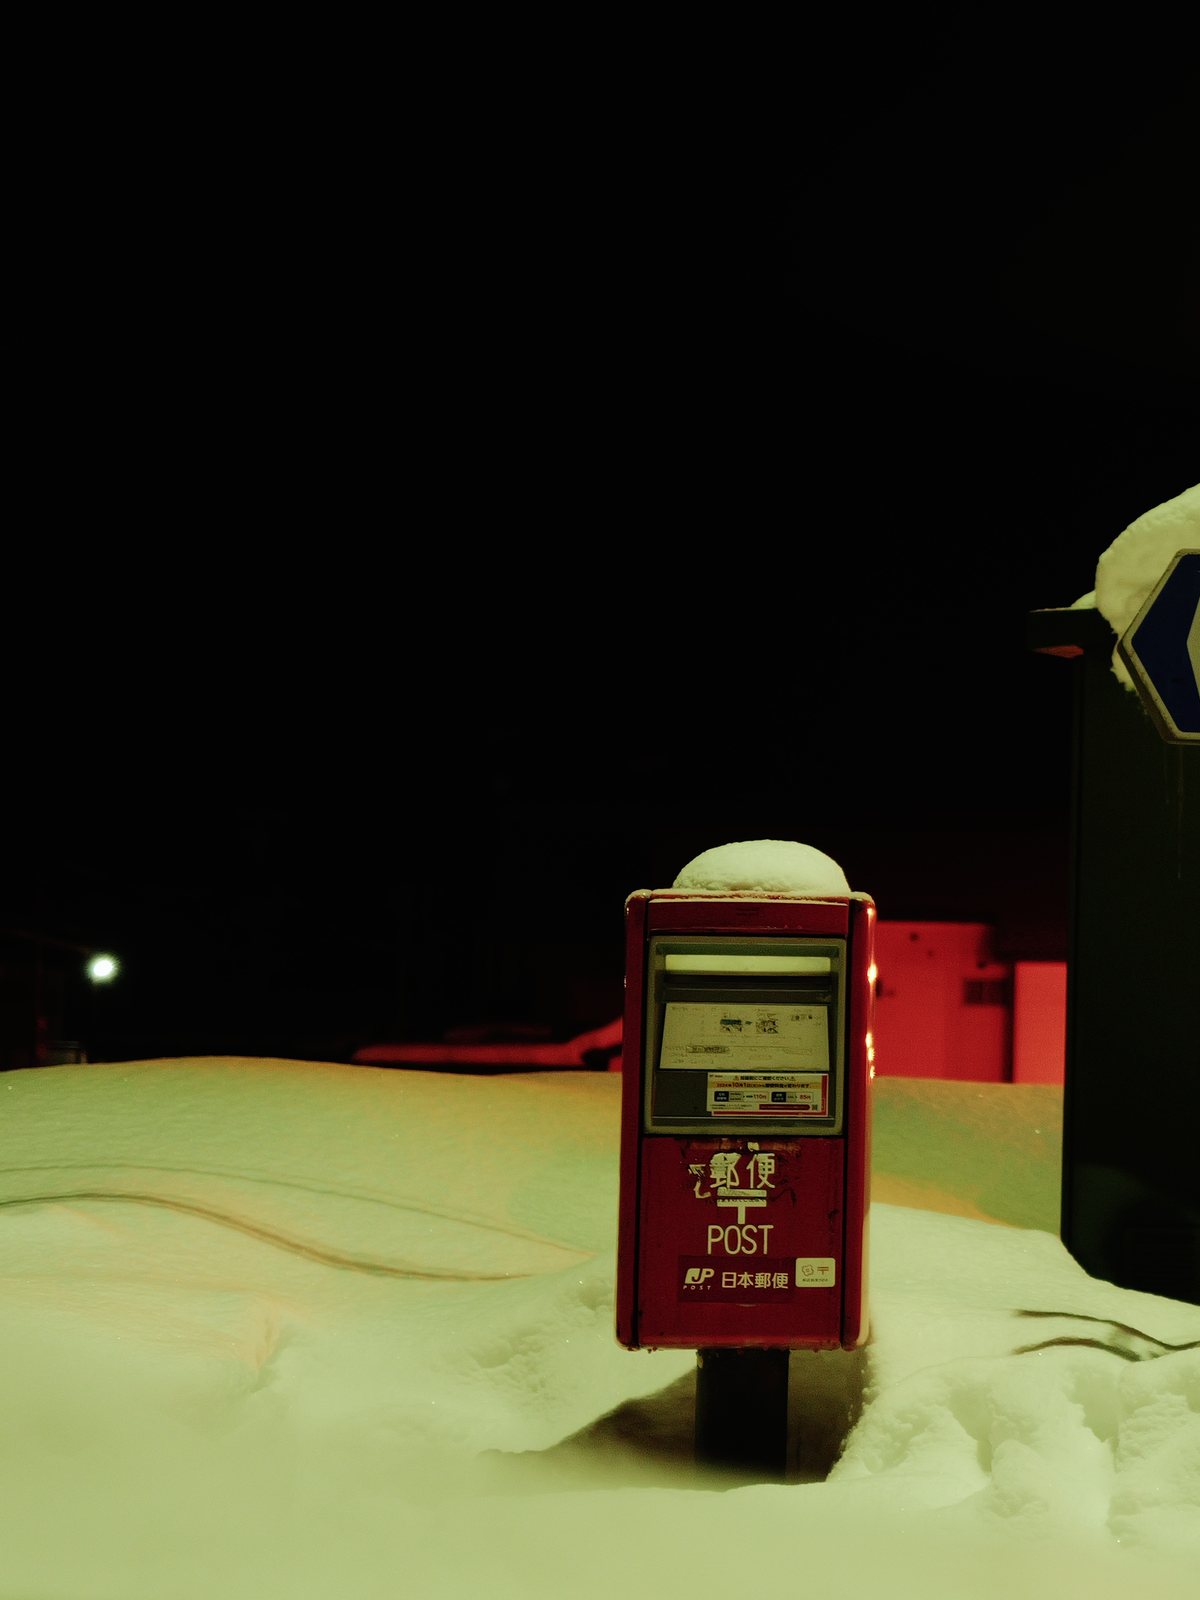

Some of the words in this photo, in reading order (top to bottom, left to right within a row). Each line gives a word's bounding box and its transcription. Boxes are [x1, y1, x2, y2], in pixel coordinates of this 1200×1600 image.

[709, 1152, 775, 1189] 郵便
[707, 1224, 774, 1255] POST
[721, 1271, 789, 1289] 日本郵便
